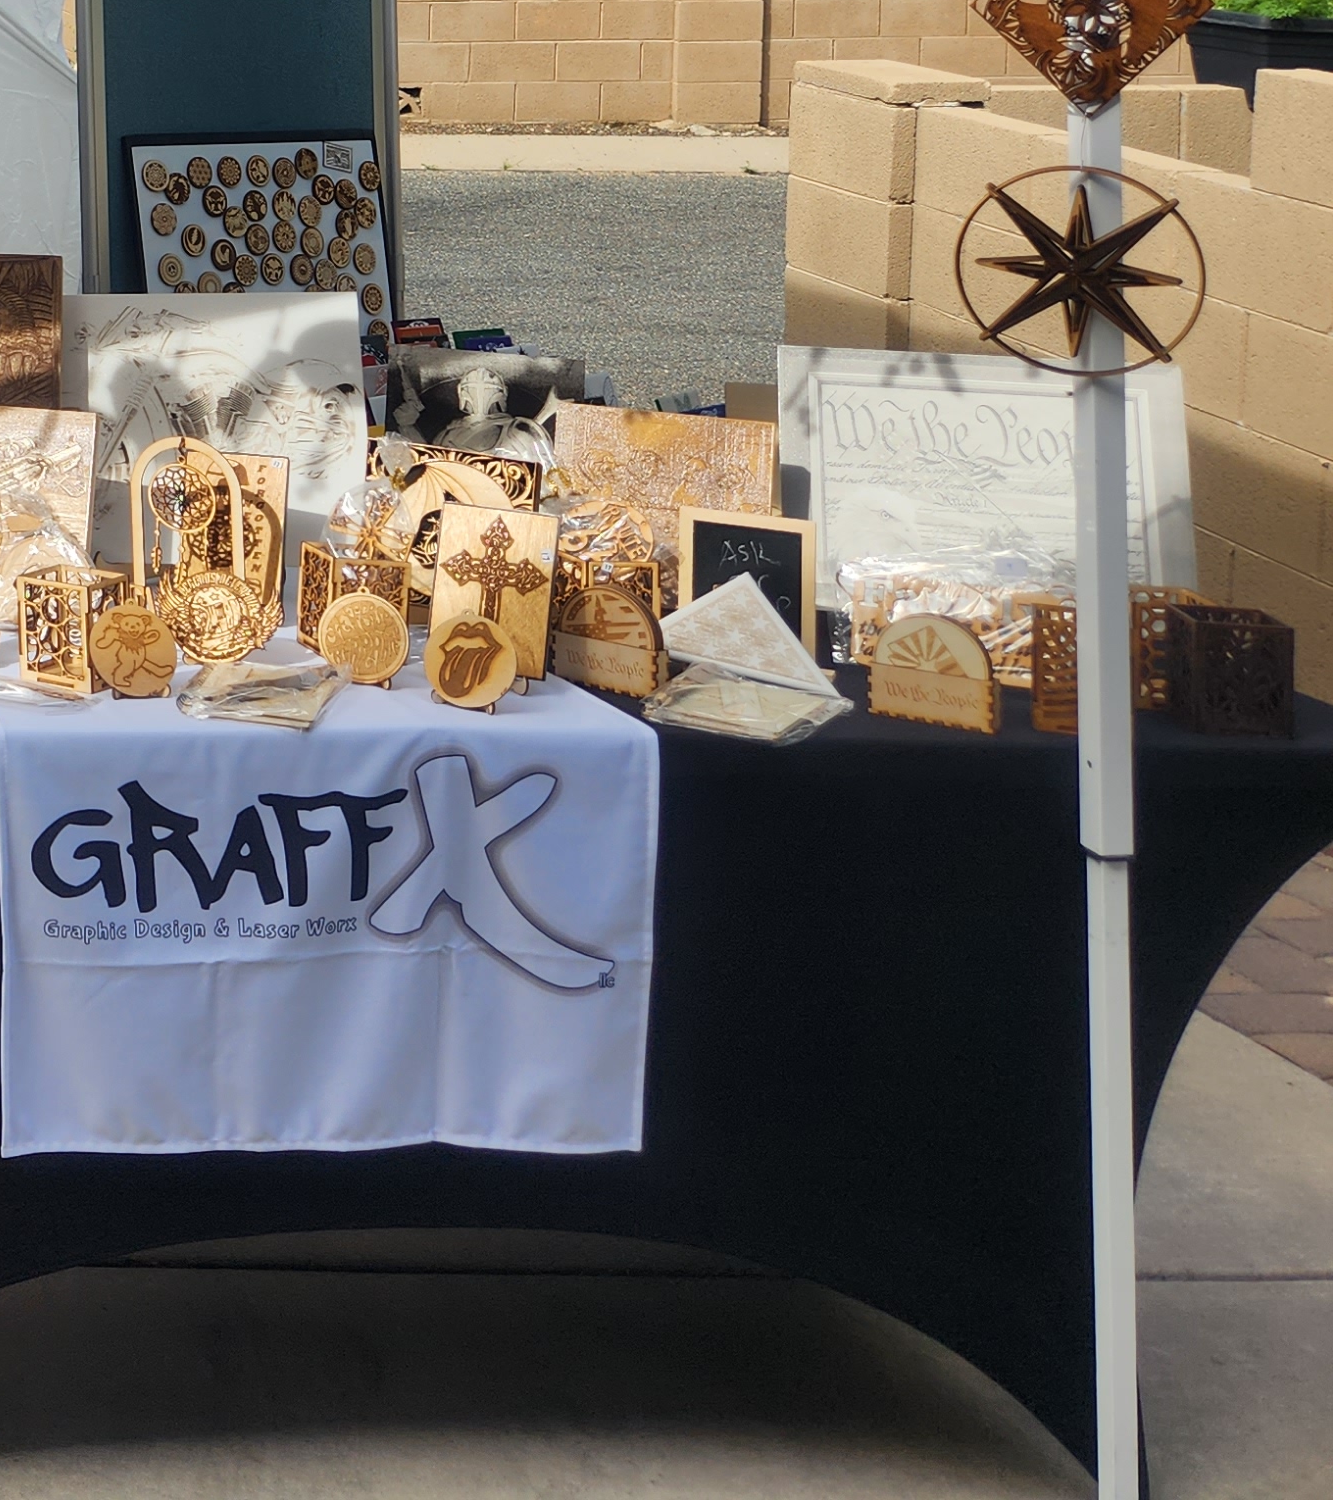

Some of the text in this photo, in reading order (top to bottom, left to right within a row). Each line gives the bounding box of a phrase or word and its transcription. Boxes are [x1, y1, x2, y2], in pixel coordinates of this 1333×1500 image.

[43, 915, 358, 945] Graphic Design & Laser Worx
